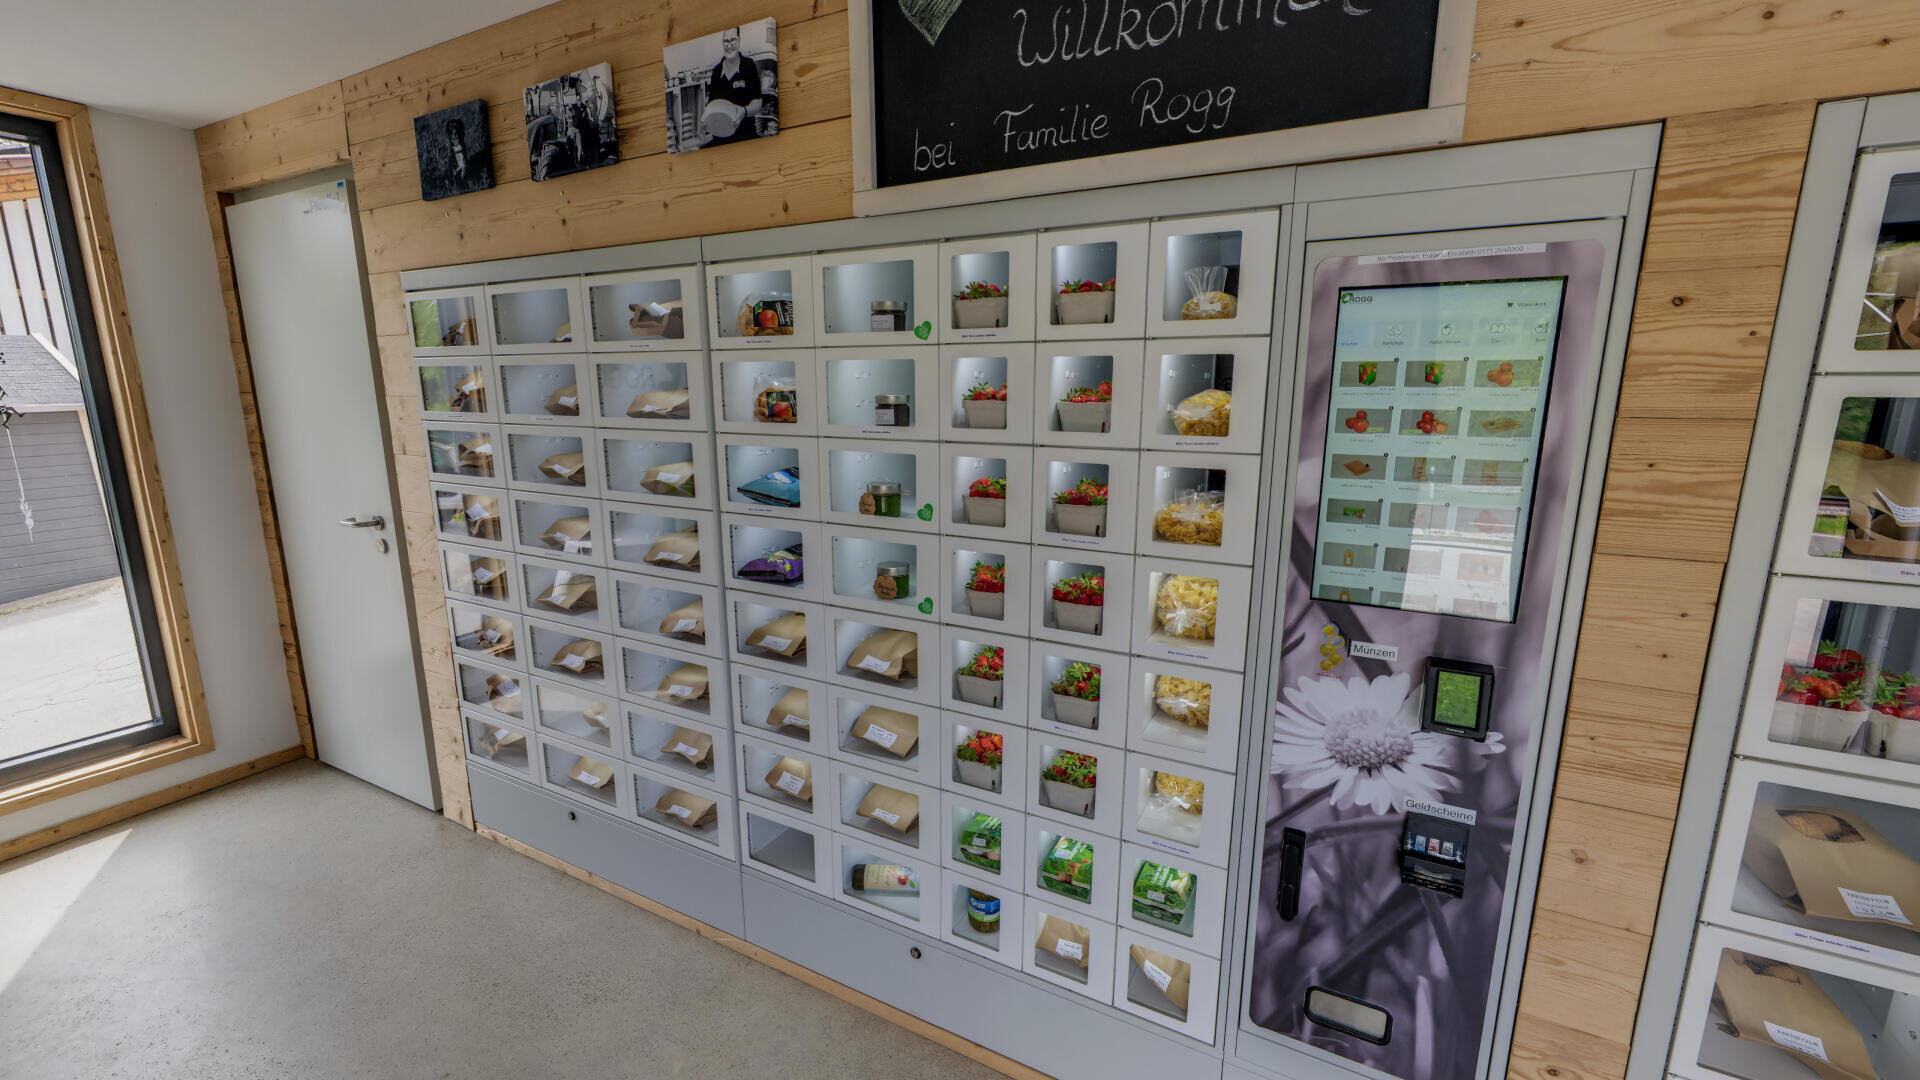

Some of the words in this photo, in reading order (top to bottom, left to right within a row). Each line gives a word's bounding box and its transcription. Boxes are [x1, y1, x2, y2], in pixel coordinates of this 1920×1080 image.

[1013, 0, 1373, 67] Willkomm
[913, 121, 957, 172] bei
[993, 103, 1111, 153] Familie
[1131, 77, 1236, 133] Rogg
[1353, 643, 1396, 659] Münzen
[1405, 797, 1475, 823] Geldscheine
